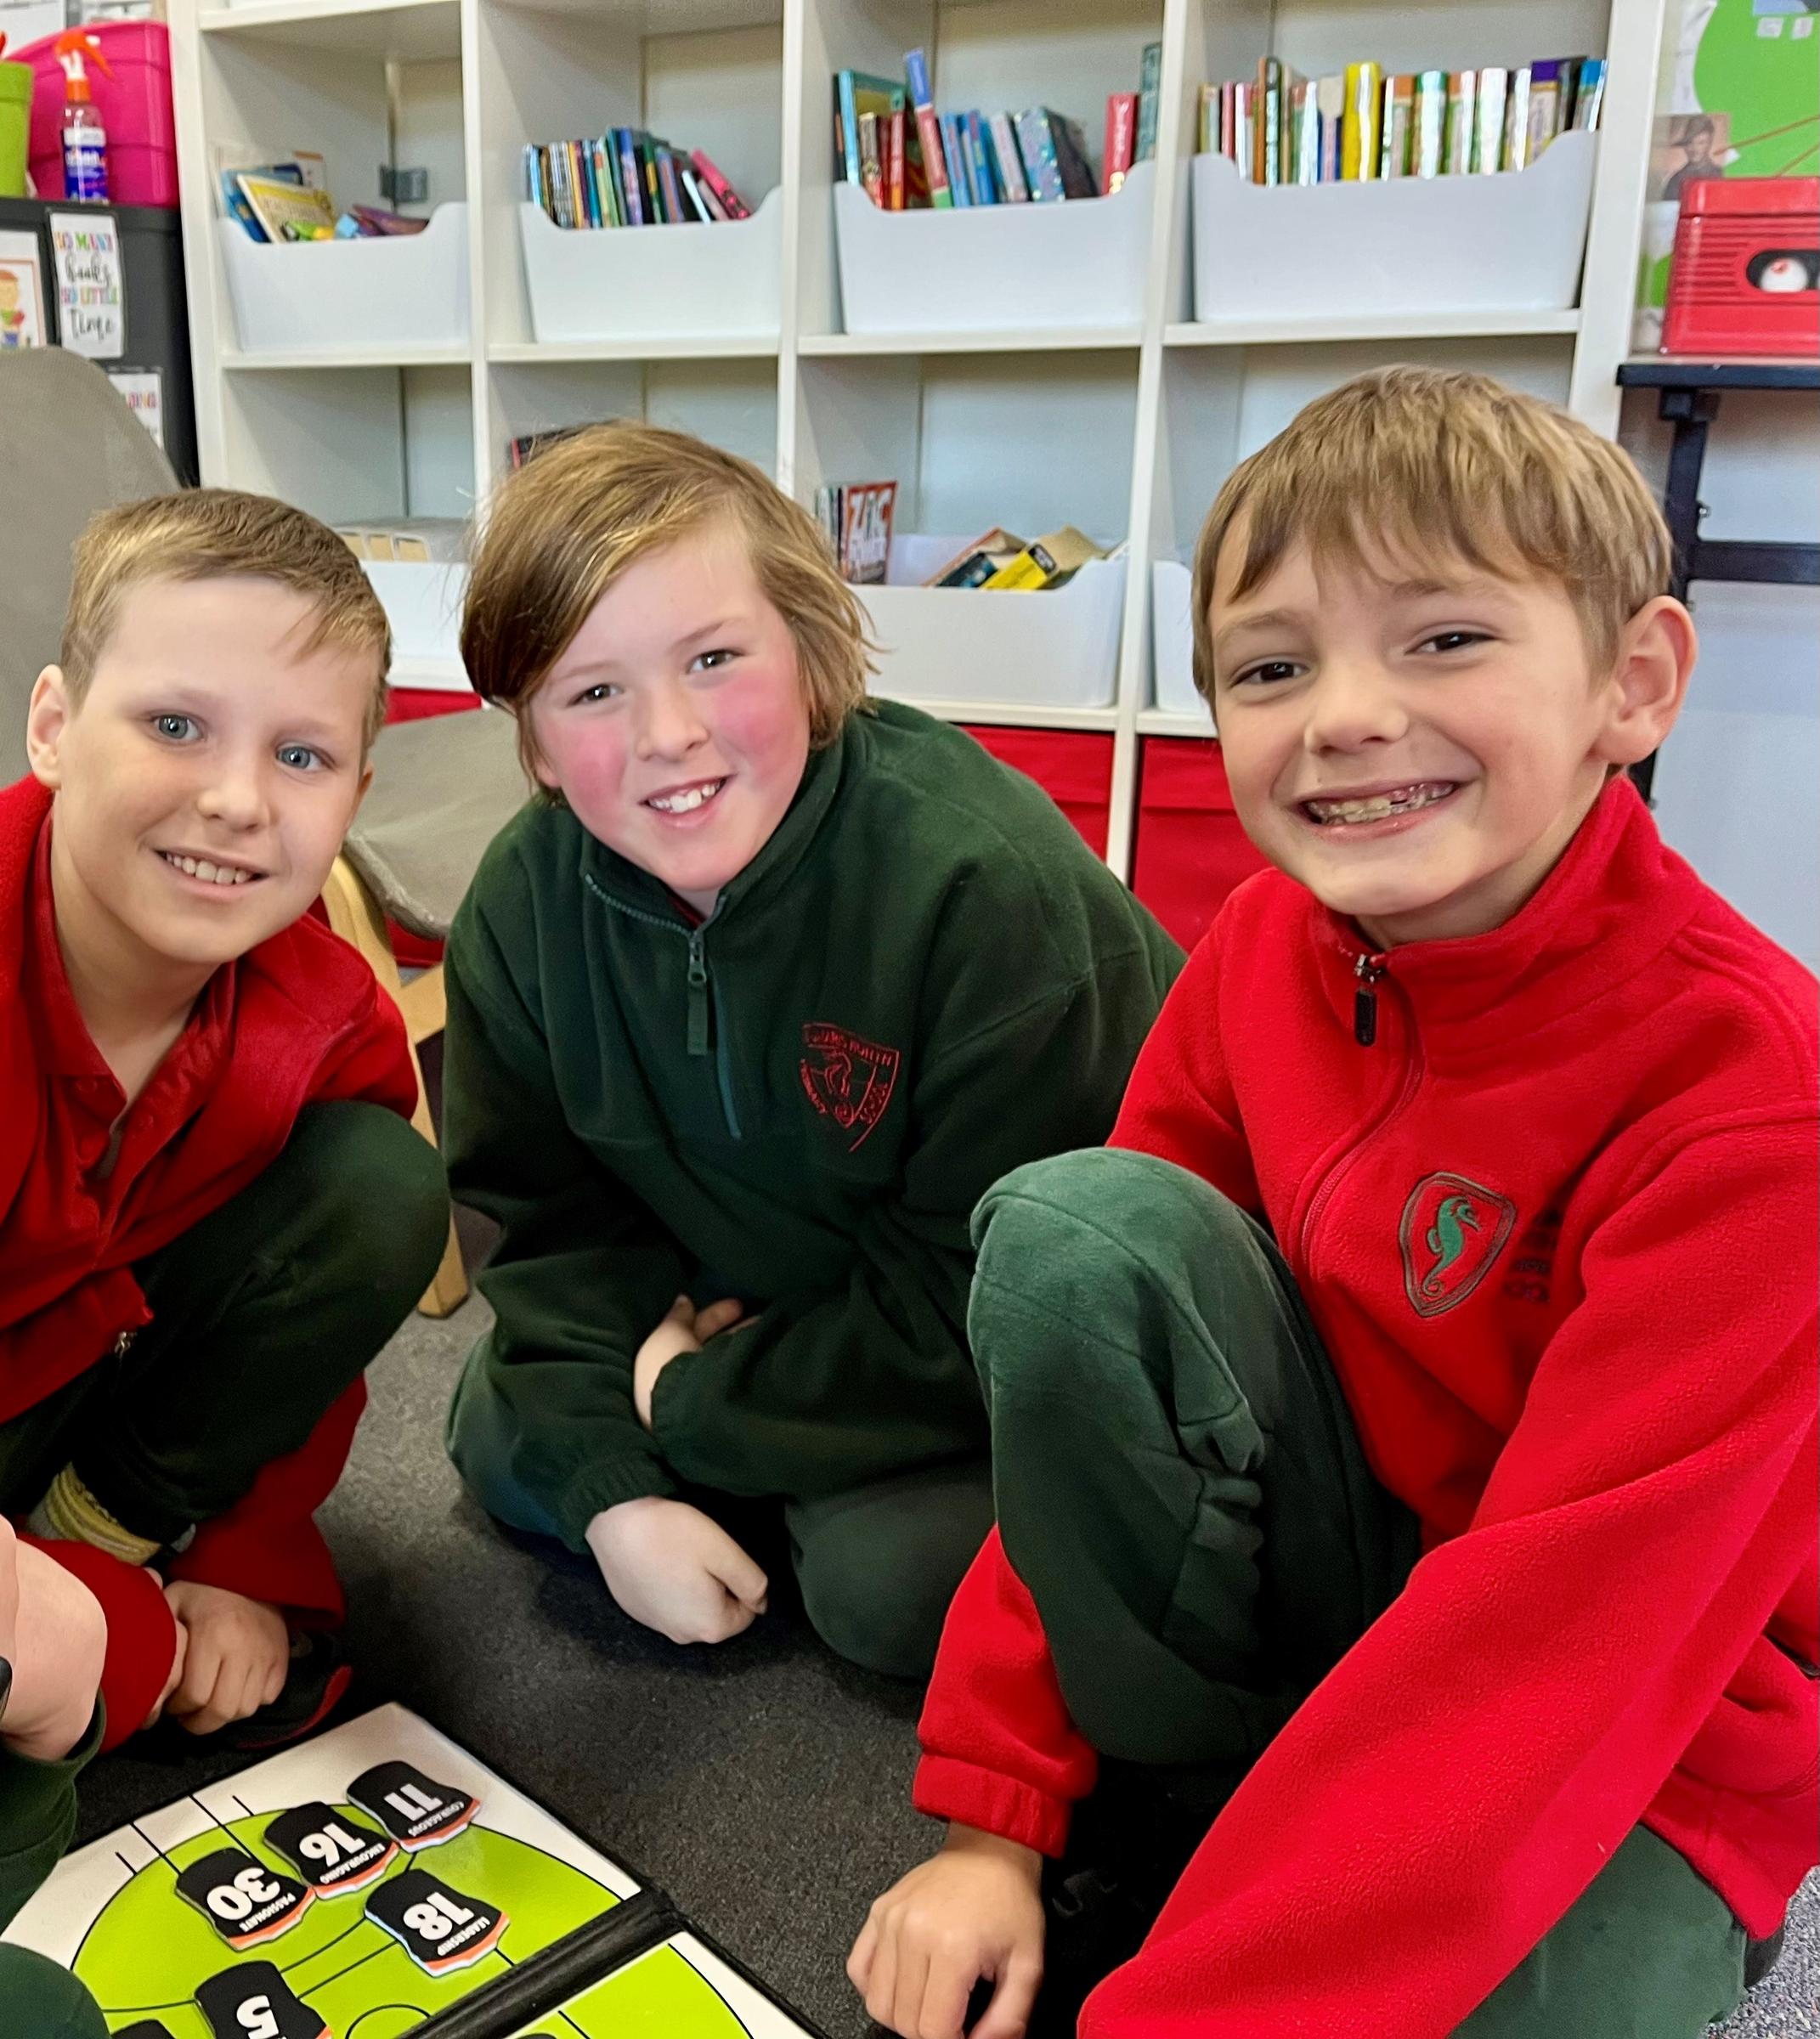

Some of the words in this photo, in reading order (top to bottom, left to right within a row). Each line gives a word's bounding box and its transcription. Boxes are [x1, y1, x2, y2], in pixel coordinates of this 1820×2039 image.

[384, 1783, 444, 1822] 11
[299, 1822, 366, 1867] 16
[319, 1843, 386, 1884] ENCOURAGING
[206, 1867, 280, 1920] 30
[239, 1892, 297, 1933] PASSIONATE
[403, 1891, 475, 1940] 18
[437, 1916, 491, 1957] LEADERSHIP
[236, 1995, 280, 2039] 5
